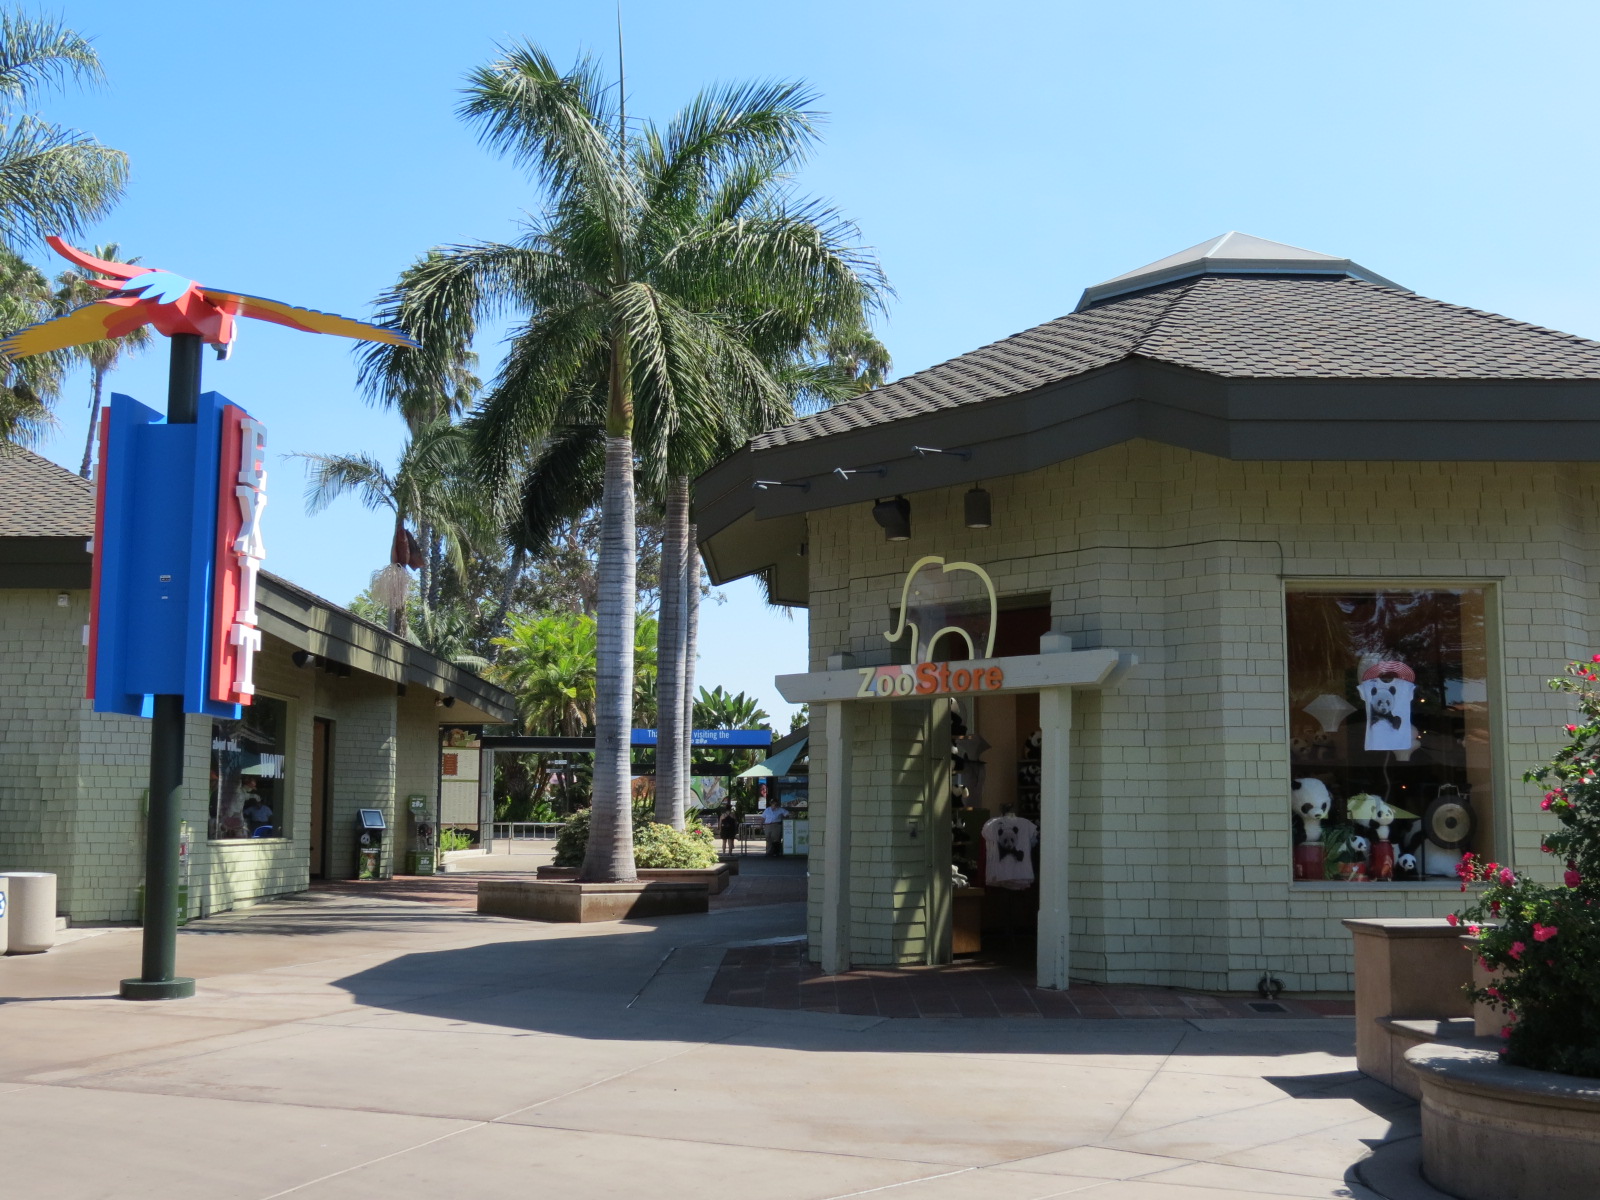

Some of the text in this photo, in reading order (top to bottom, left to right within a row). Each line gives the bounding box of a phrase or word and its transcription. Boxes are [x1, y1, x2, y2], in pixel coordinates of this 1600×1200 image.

[230, 417, 267, 696] EXIT
[693, 730, 718, 740] visiting
[719, 731, 730, 739] the
